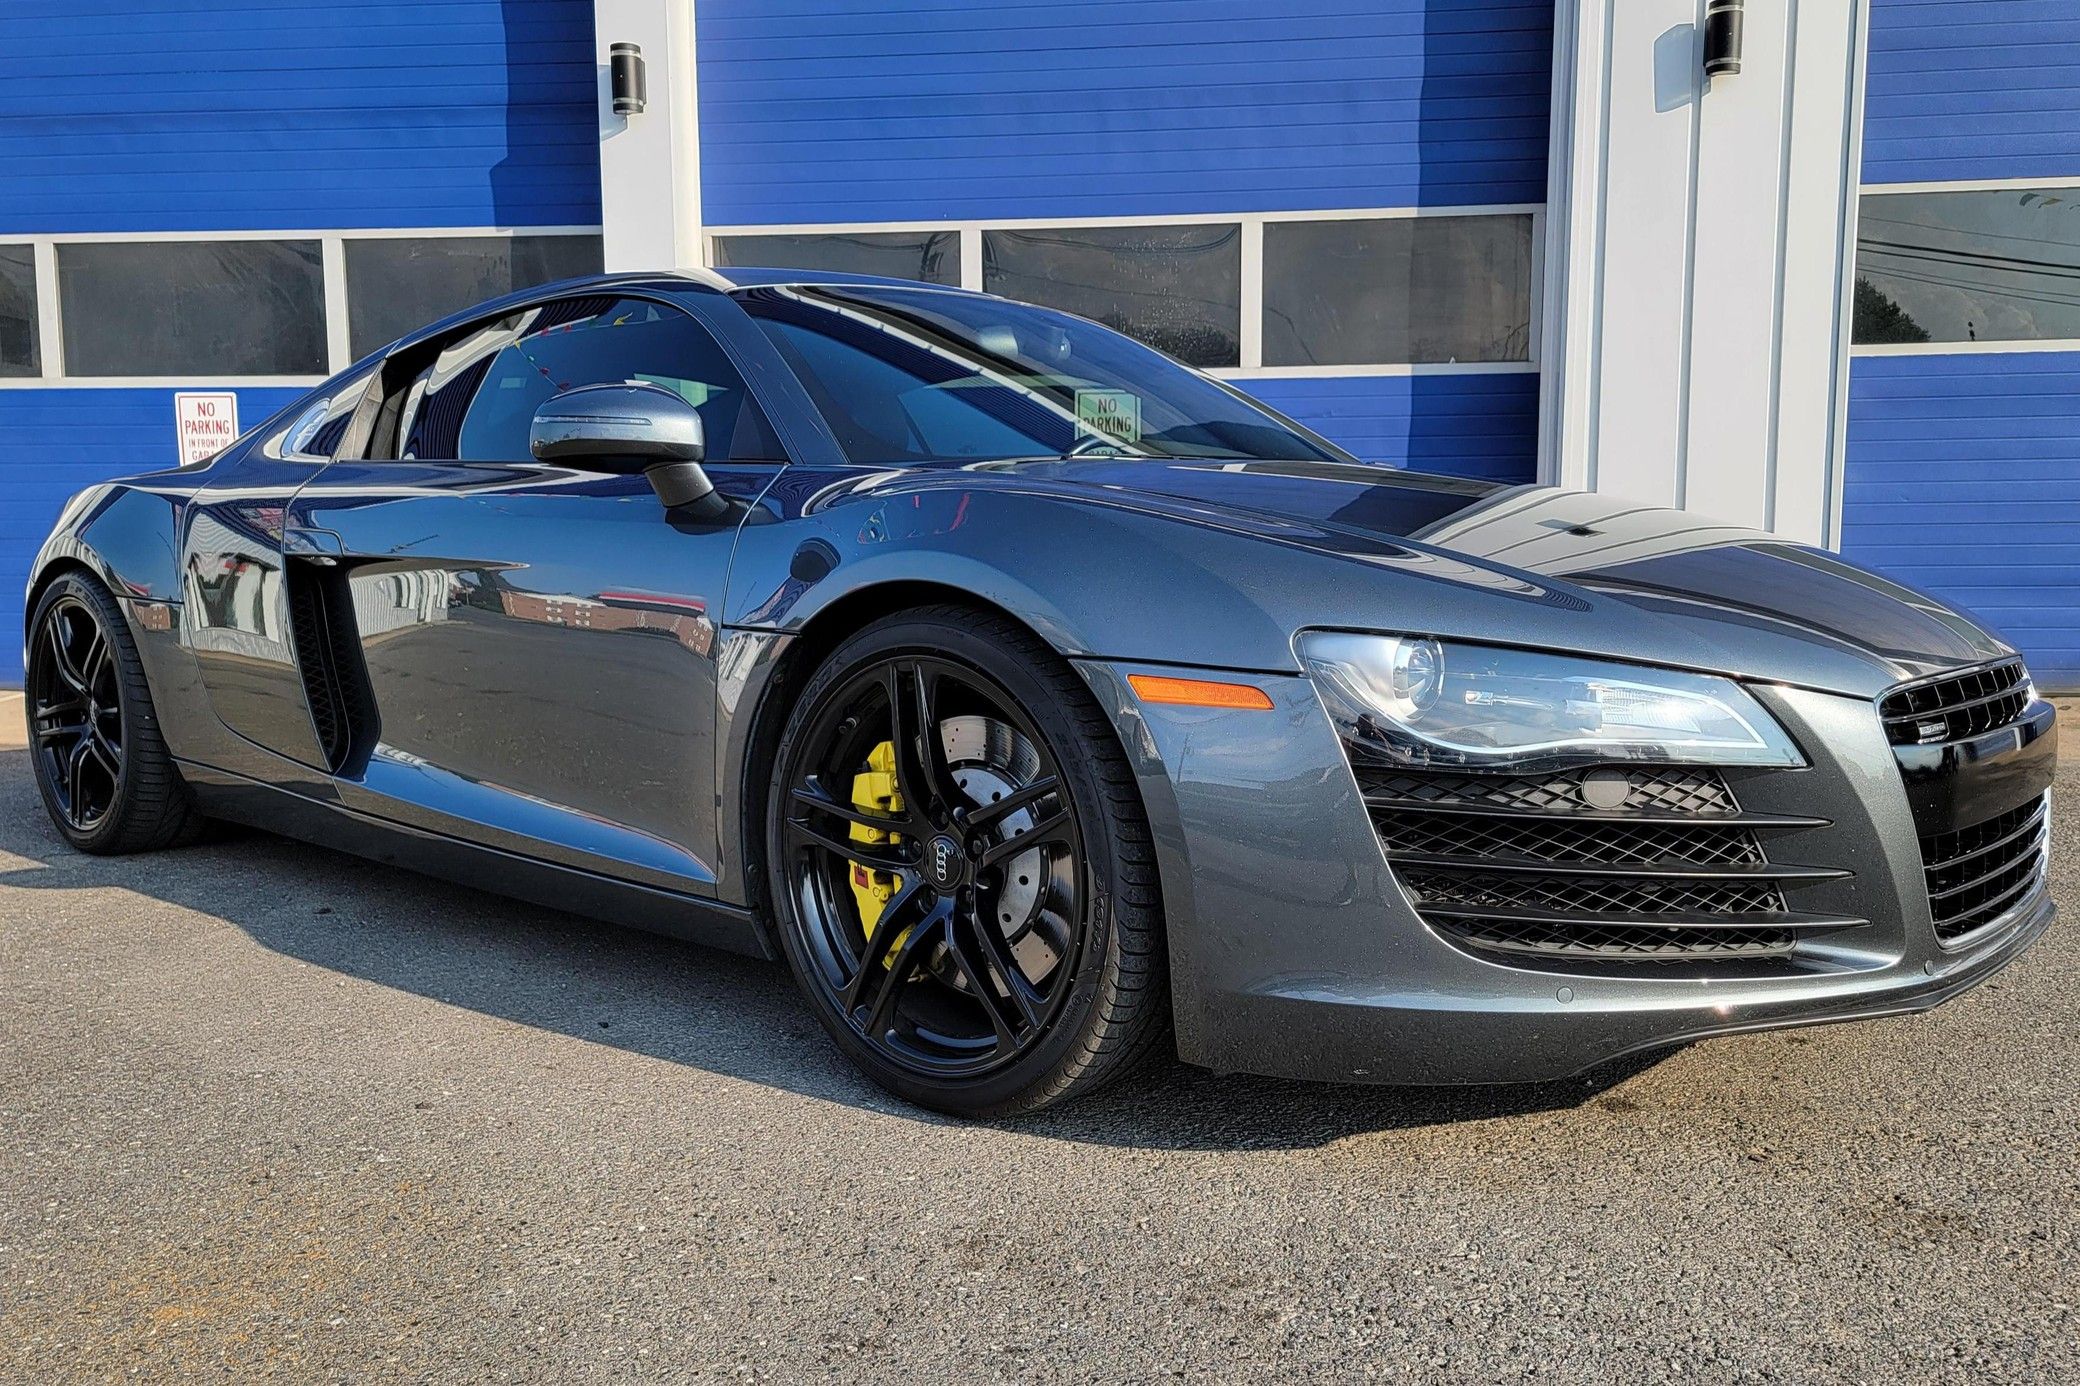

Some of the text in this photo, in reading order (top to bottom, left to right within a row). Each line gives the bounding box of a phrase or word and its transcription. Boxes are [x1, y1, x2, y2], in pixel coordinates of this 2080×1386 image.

[197, 402, 215, 417] NO
[1098, 398, 1117, 414] NO
[185, 420, 230, 434] PARKING
[189, 438, 229, 448] IN FRONT OF
